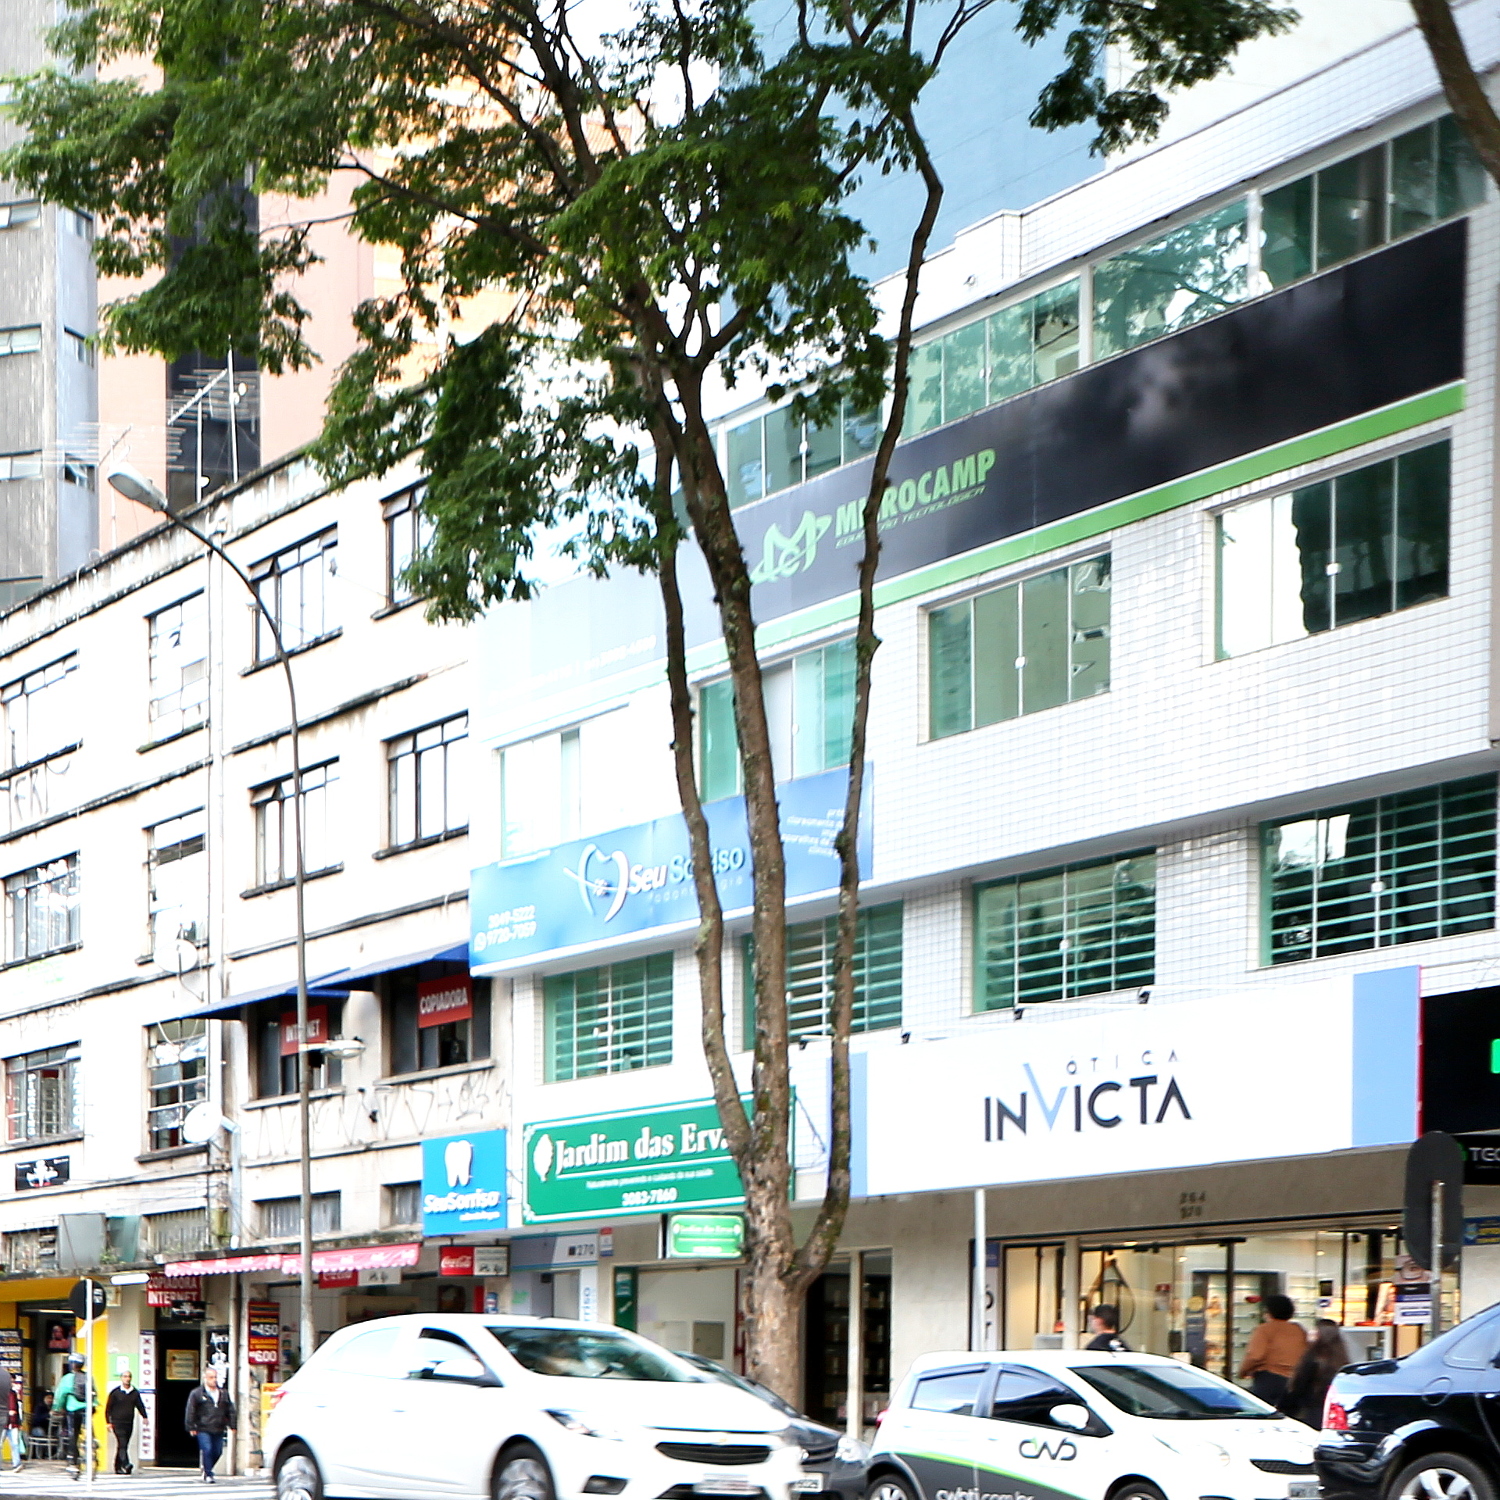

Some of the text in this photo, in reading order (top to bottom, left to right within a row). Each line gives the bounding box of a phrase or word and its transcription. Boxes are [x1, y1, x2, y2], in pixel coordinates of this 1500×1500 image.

[835, 448, 997, 538] MIROCAMP
[628, 846, 745, 894] Seu Soiso
[419, 986, 469, 1015] COPIADORA
[285, 1018, 320, 1043] INTNET
[984, 1062, 1192, 1142] INVICTA
[555, 1123, 730, 1176] Jardim das Erv
[147, 1274, 199, 1290] COPIADORA
[147, 1290, 199, 1306] INTERNET
[142, 1337, 151, 1386] XEROX
